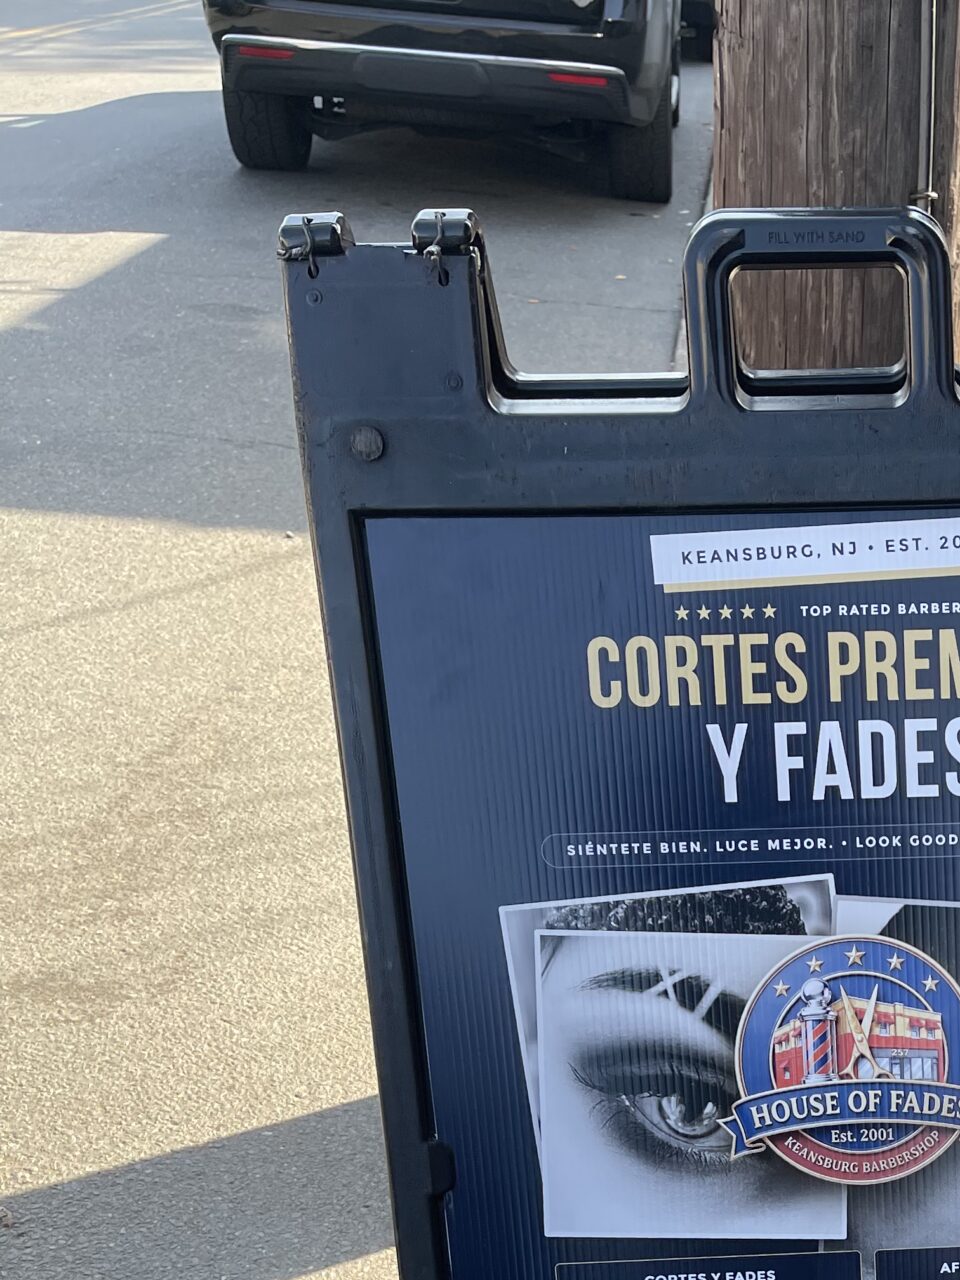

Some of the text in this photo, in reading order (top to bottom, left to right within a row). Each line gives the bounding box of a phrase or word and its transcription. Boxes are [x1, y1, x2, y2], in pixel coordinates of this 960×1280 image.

[768, 230, 865, 244] FILL WITH SAND
[681, 543, 823, 566] KEANSBURG,
[831, 540, 858, 556] NJ
[885, 537, 930, 553] EST.
[800, 605, 834, 618] TOP
[838, 603, 891, 616] RATED
[587, 631, 808, 709] CORTES
[706, 723, 748, 803] Y
[566, 840, 653, 856] SIÉNTETE
[660, 841, 708, 854] BIEN.
[715, 839, 760, 852] LUCE
[768, 837, 833, 851] MEJOR.
[856, 835, 902, 848] LOOK
[750, 1092, 840, 1129] HOUSE
[848, 1090, 882, 1113] OF
[831, 1128, 895, 1143] Est. 2001
[784, 1130, 940, 1173] KEANSBURG BARBERSHOP
